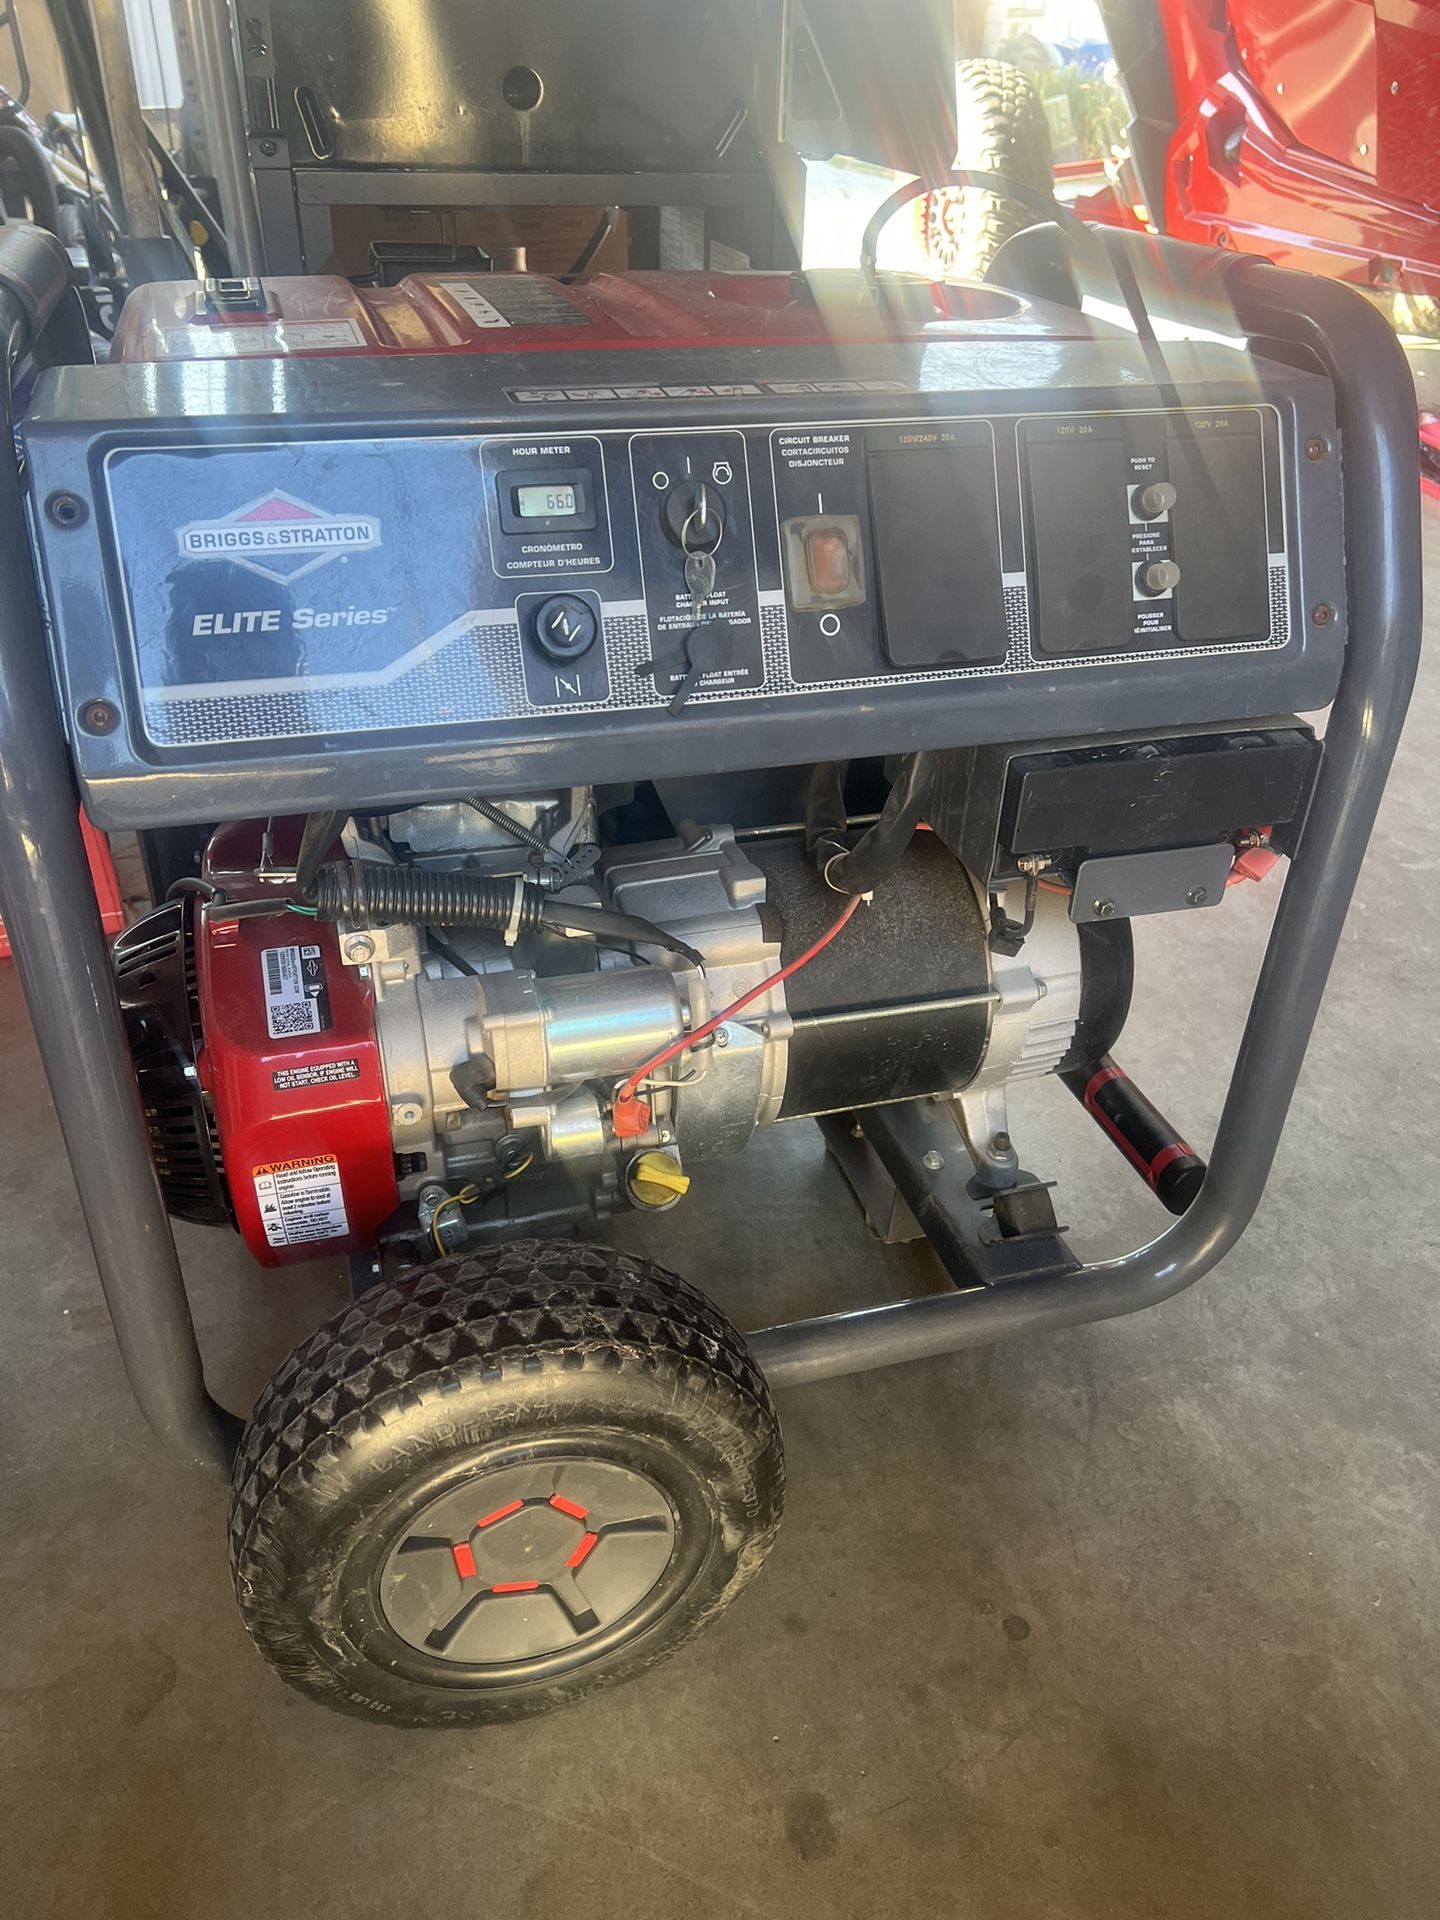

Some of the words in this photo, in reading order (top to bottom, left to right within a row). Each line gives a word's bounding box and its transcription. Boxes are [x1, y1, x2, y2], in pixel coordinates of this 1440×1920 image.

[1056, 425, 1075, 435] 120V
[778, 436, 811, 445] CIRCUIT
[812, 434, 850, 444] BREAKER
[512, 447, 538, 456] HOUR
[540, 446, 571, 455] METER
[781, 446, 850, 456] CORTACIRCUITOS
[788, 458, 845, 468] DISJONCTEUR
[521, 542, 583, 554] CRONÓMETRO
[506, 559, 555, 569] COMPTEUR
[558, 557, 601, 567] D'HEURES
[675, 600, 707, 608] CHAR
[709, 598, 729, 606] INPUT
[708, 612, 717, 620] LA
[718, 609, 746, 619] BATERÍA
[192, 610, 282, 636] ELITE
[291, 604, 389, 630] Series
[657, 623, 667, 631] DE
[702, 670, 722, 679] FLOAT
[723, 668, 749, 677] ENTRÉE
[699, 677, 735, 686] CHARGEUR
[290, 1067, 309, 1075] ENGINE
[310, 1062, 337, 1072] EQUIPPED
[337, 1060, 350, 1068] WITH
[325, 1067, 345, 1076] ENGINE
[310, 1076, 328, 1084] CHECK
[269, 1155, 334, 1172] WARNING
